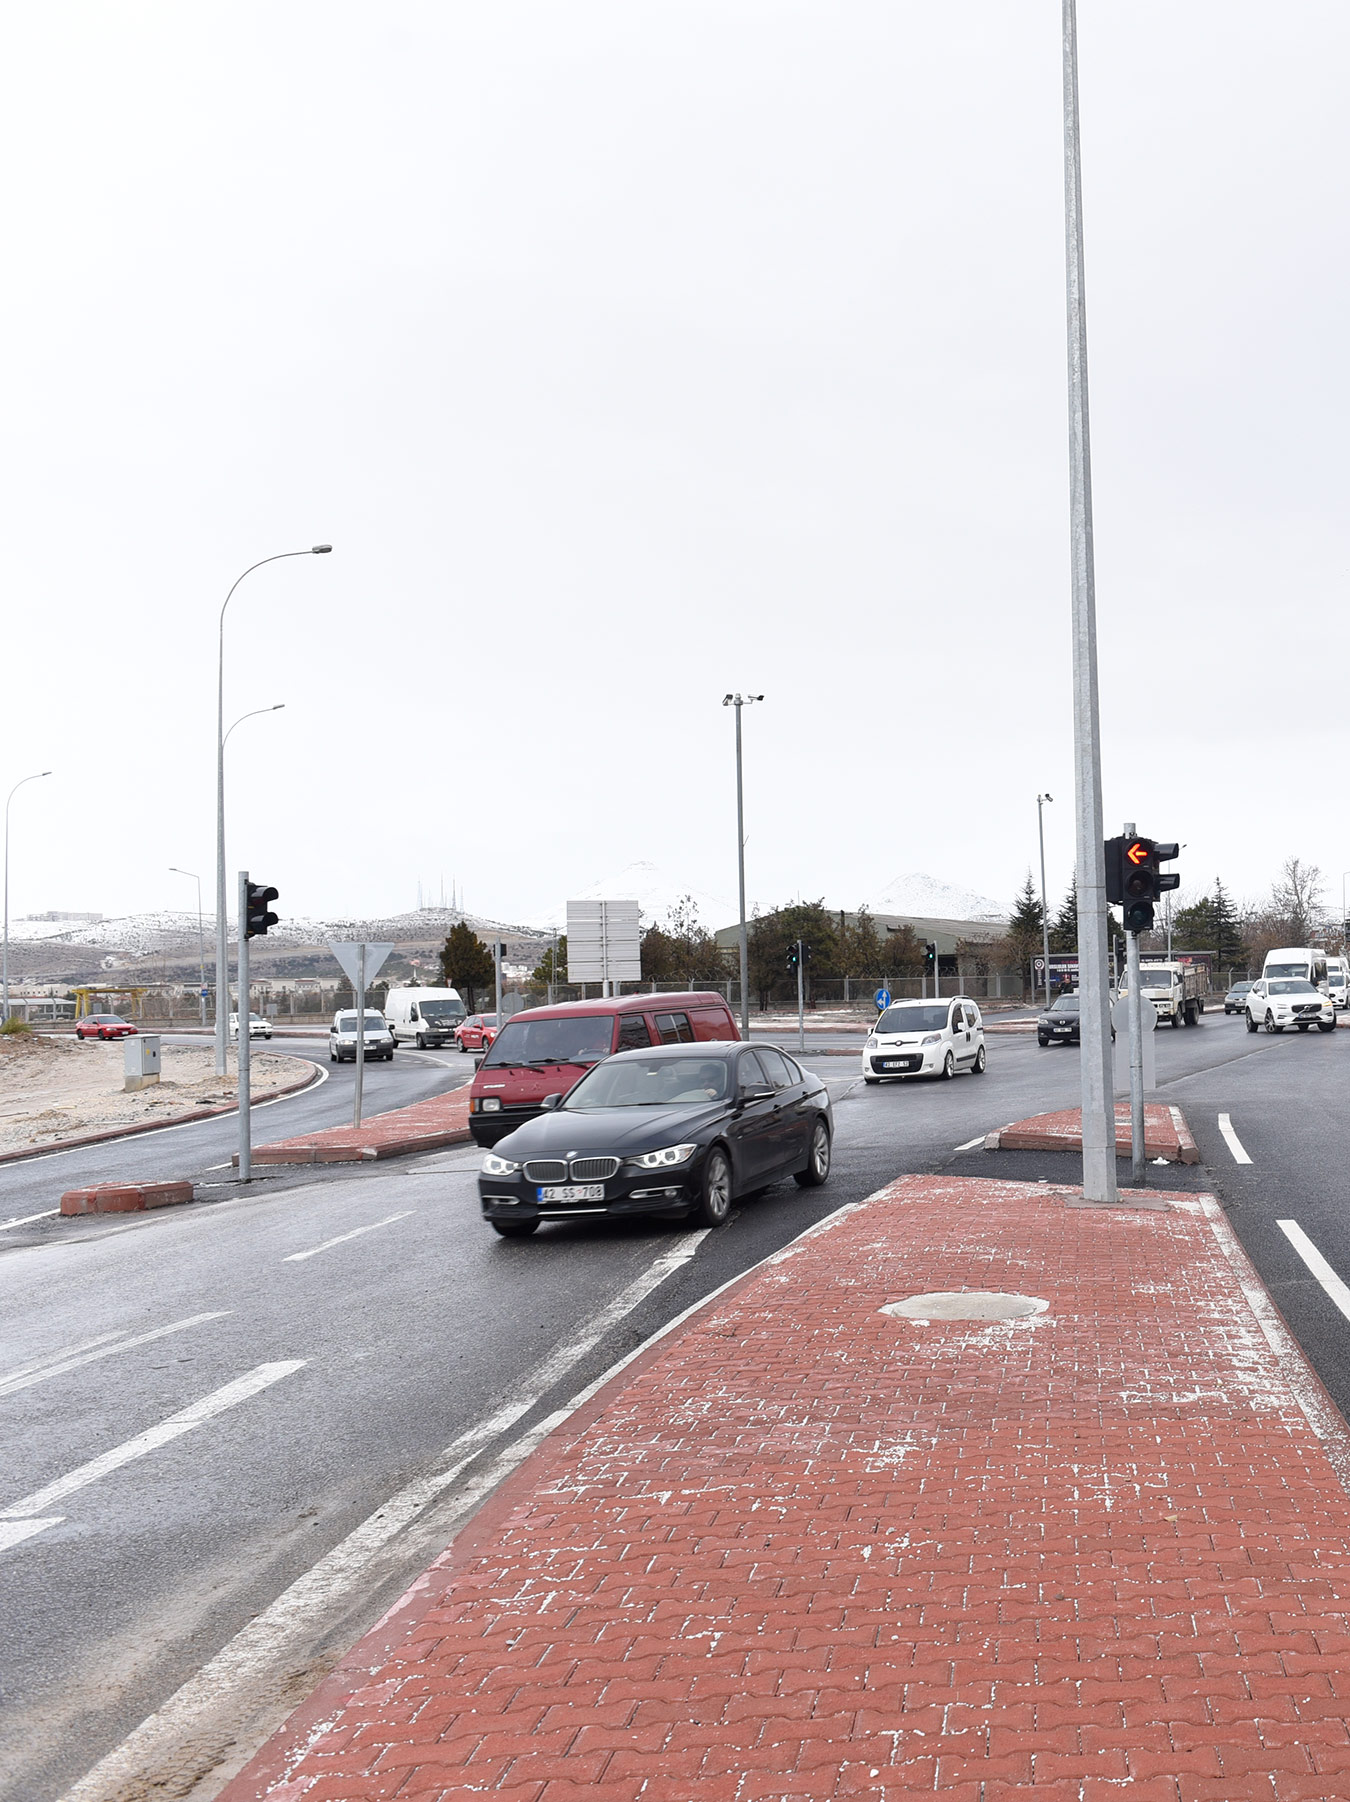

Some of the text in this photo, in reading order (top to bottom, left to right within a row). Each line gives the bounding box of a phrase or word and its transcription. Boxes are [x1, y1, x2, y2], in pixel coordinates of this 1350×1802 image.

[544, 1186, 602, 1199] 42 SS 708
